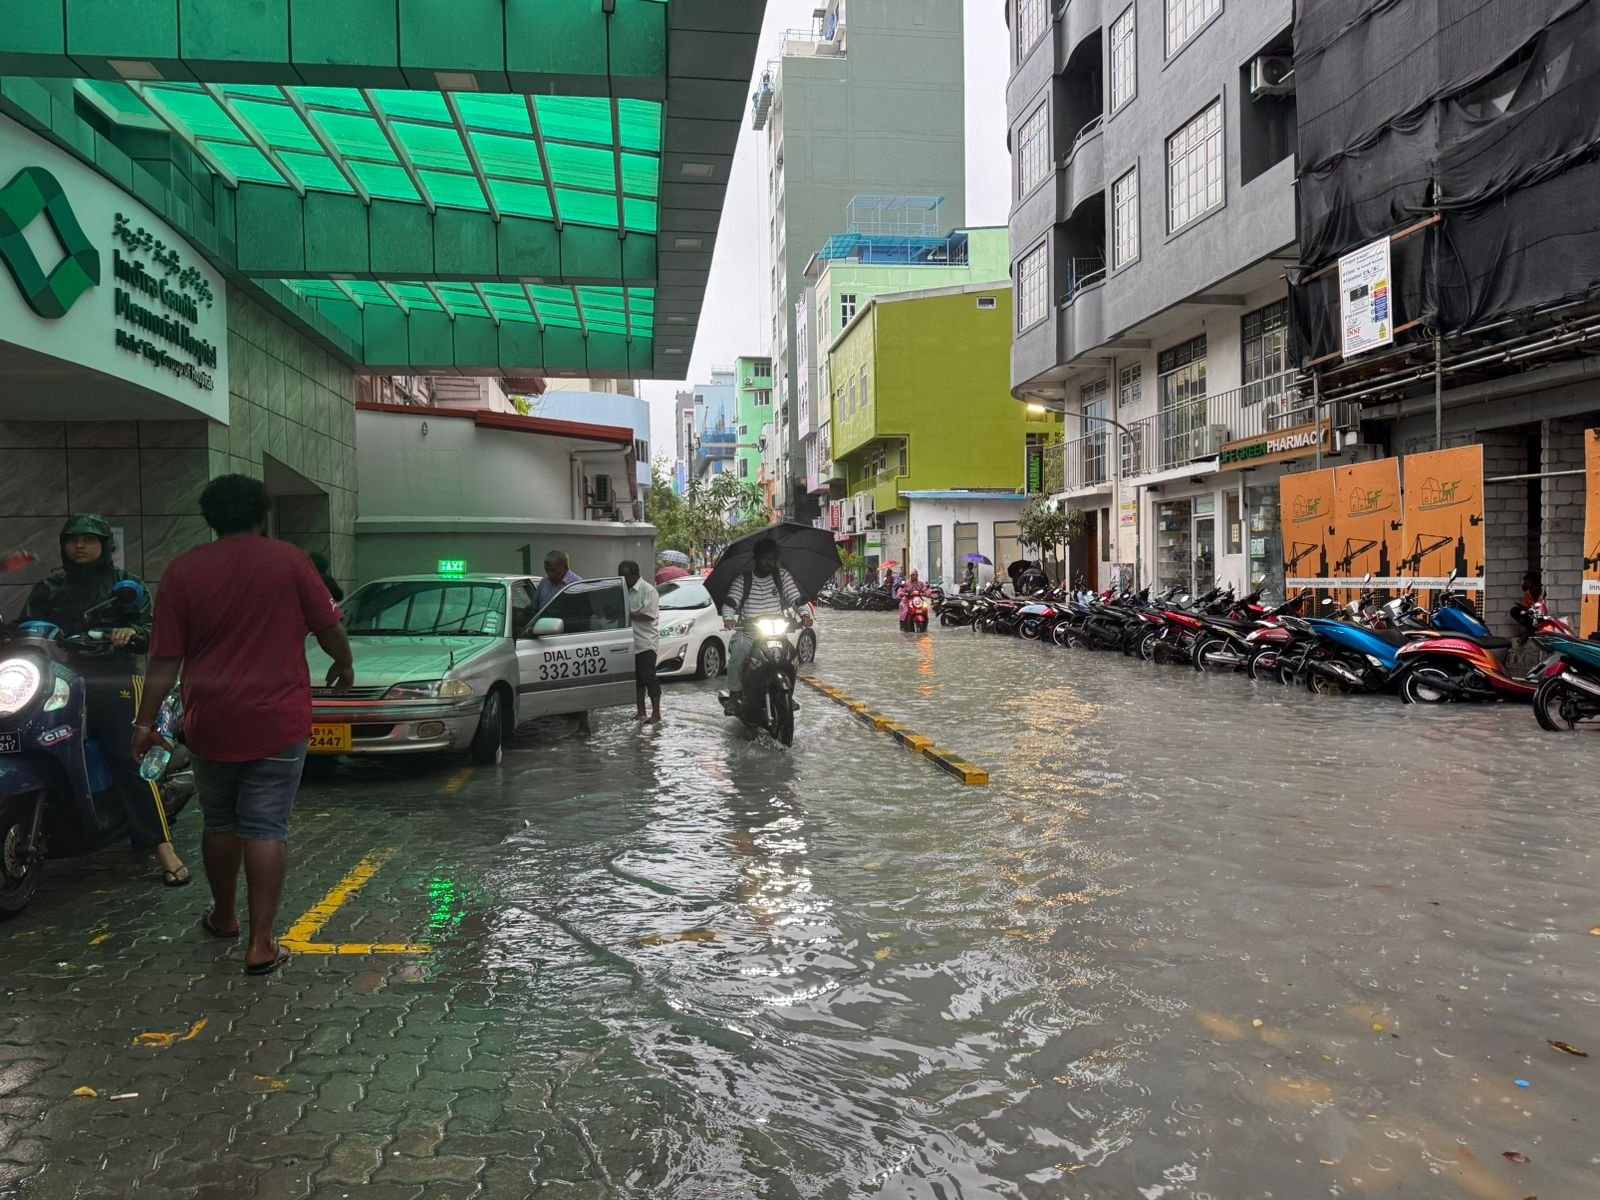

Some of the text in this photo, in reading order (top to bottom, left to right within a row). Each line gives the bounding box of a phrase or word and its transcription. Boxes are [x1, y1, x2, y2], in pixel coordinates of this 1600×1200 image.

[113, 249, 159, 298] Indira
[159, 278, 198, 324] Gandhi
[114, 288, 217, 369] Memorial Hospital
[1236, 442, 1267, 462] GREEN
[1266, 429, 1327, 454] PHARMACY
[1030, 452, 1040, 493] PHARMACY
[440, 560, 464, 571] TAXI
[543, 646, 600, 663] DIAL CAB
[310, 736, 342, 747] 2447
[312, 728, 334, 736] B1A
